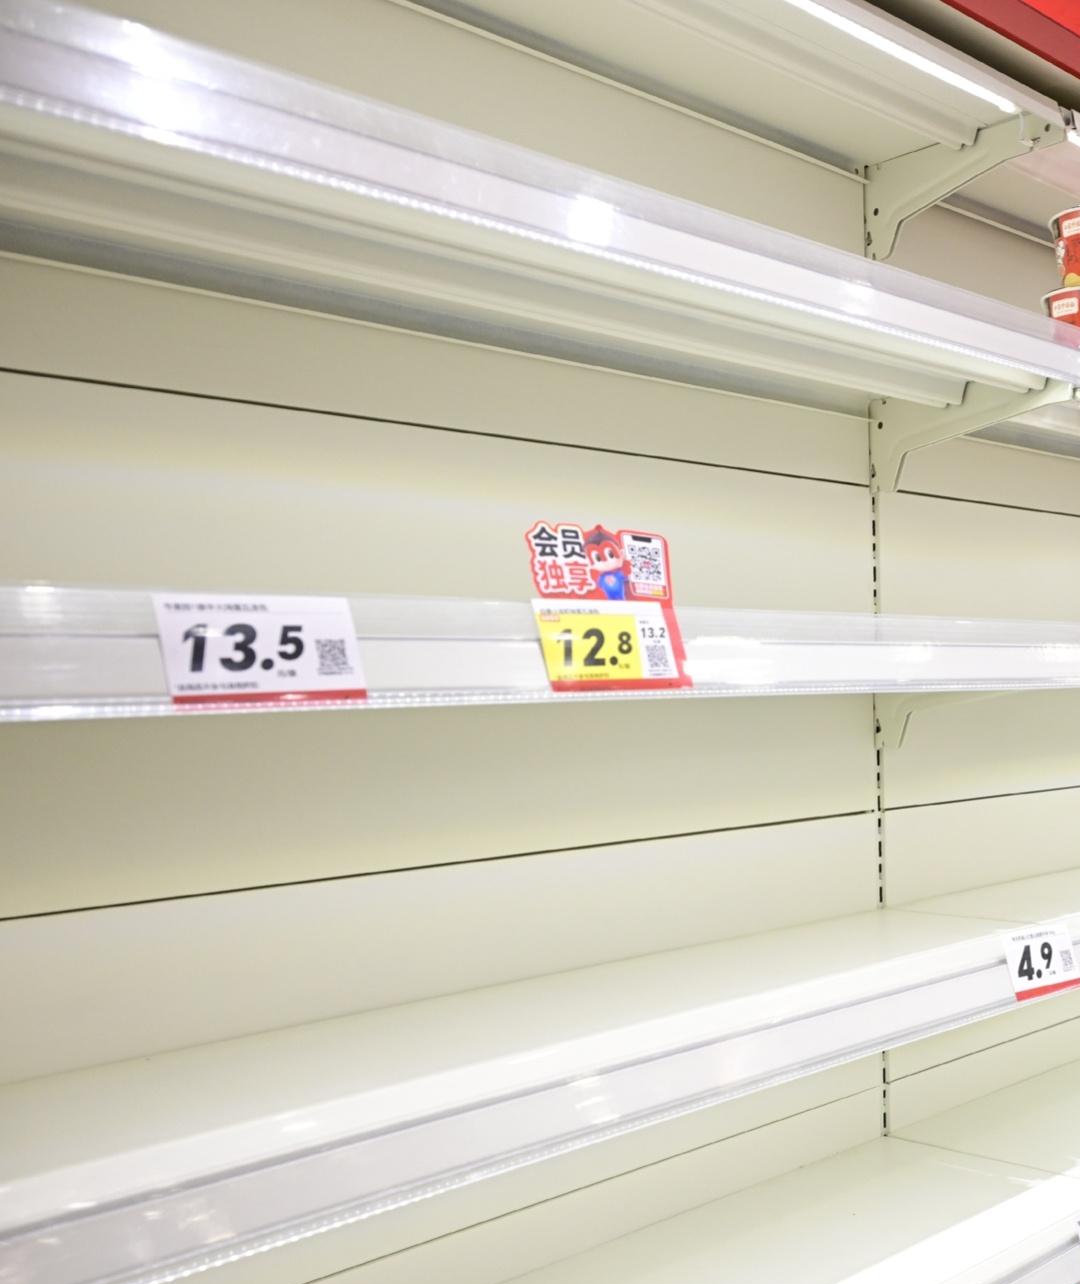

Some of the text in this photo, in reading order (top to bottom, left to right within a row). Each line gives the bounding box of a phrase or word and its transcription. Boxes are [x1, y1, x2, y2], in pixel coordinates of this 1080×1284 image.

[532, 525, 587, 560] 会员
[538, 559, 594, 593] 独享
[182, 622, 305, 674] 13.5
[556, 627, 633, 668] 12.8
[641, 626, 666, 640] 13.2
[1018, 941, 1053, 981] 4.9
